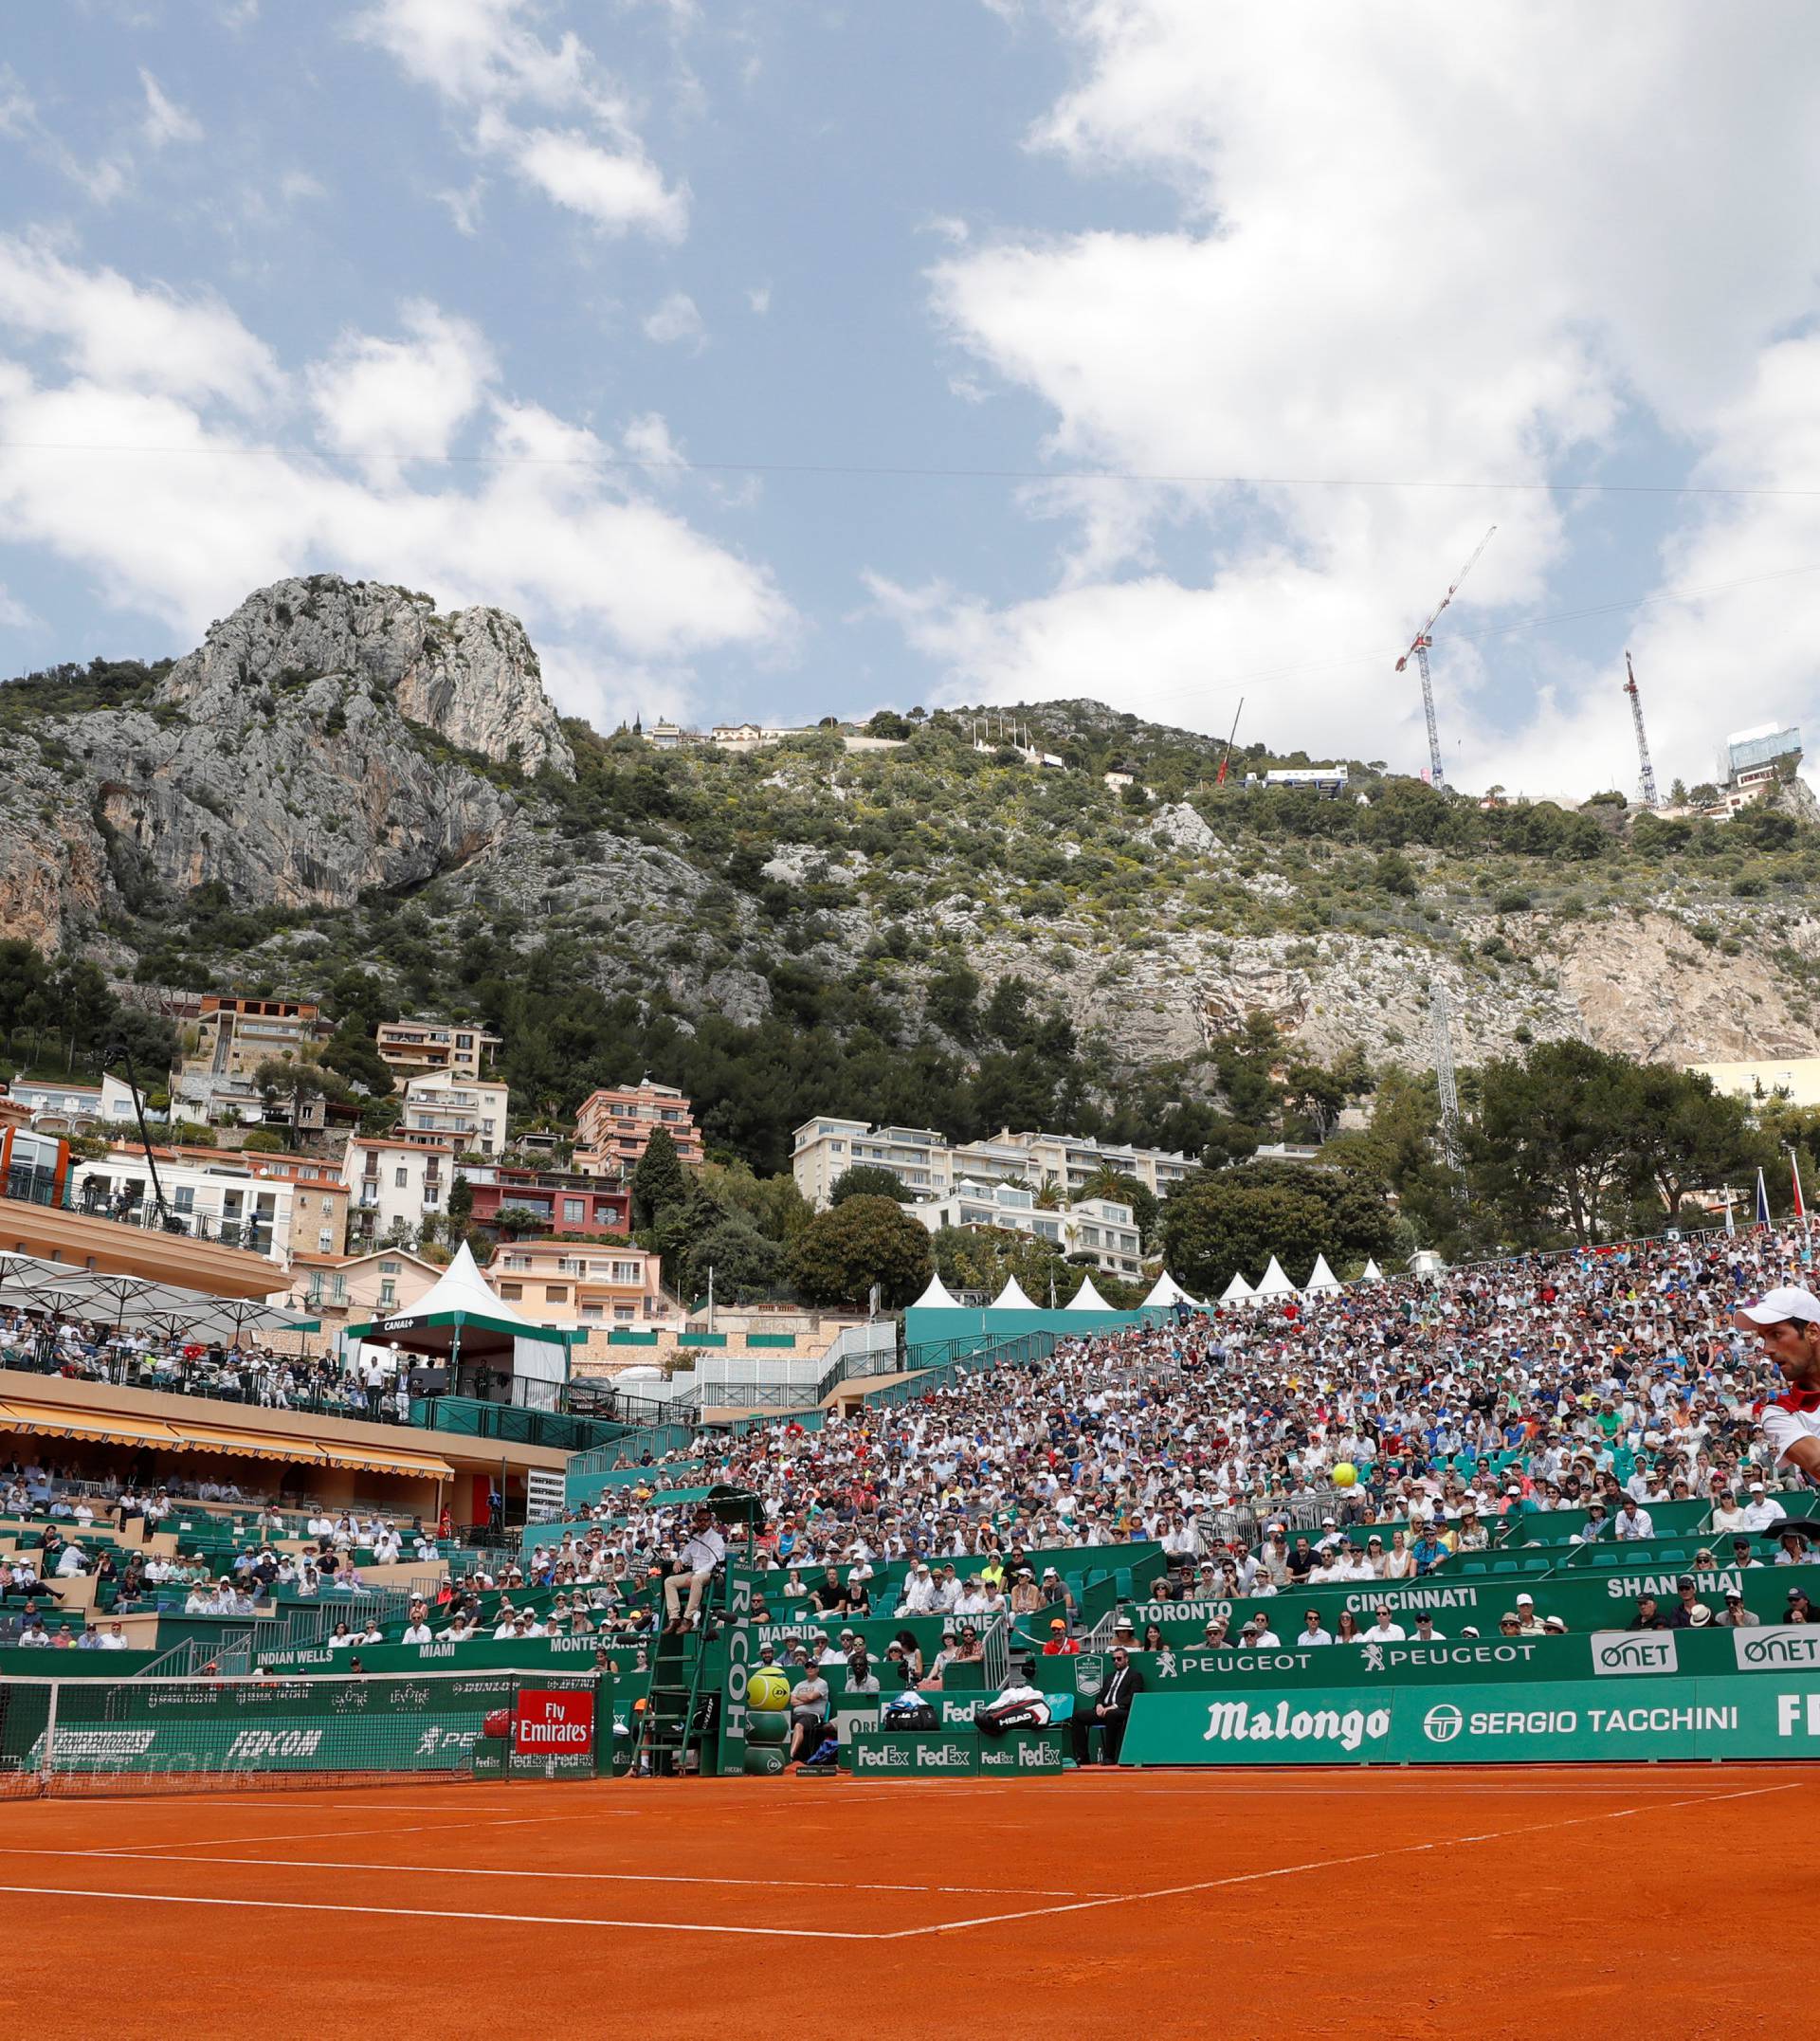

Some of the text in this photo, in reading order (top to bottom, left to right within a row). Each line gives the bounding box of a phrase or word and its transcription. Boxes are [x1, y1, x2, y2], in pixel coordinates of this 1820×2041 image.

[384, 1319, 414, 1331] CANAL+
[1347, 1588, 1477, 1613] CINCINNATI
[1136, 1601, 1232, 1623] TORONTO
[943, 1614, 992, 1634] ROME
[257, 1649, 334, 1666] INDIAN WELLS
[419, 1643, 455, 1659] MIAMI
[725, 1579, 751, 1738] RICOH
[1390, 1645, 1537, 1666] PEUGEOT
[1182, 1654, 1312, 1673] PEUGEOT
[545, 1703, 566, 1721] Fly
[999, 1712, 1032, 1726] HEAD
[1469, 1706, 1738, 1735] SERGIO TACCHINI
[520, 1721, 587, 1742] Emirates
[1203, 1701, 1391, 1752] Malongo
[858, 1745, 910, 1766] FedEx
[917, 1744, 971, 1766] FedEx
[981, 1751, 1014, 1764] FedEx
[1018, 1741, 1061, 1767] FedEx
